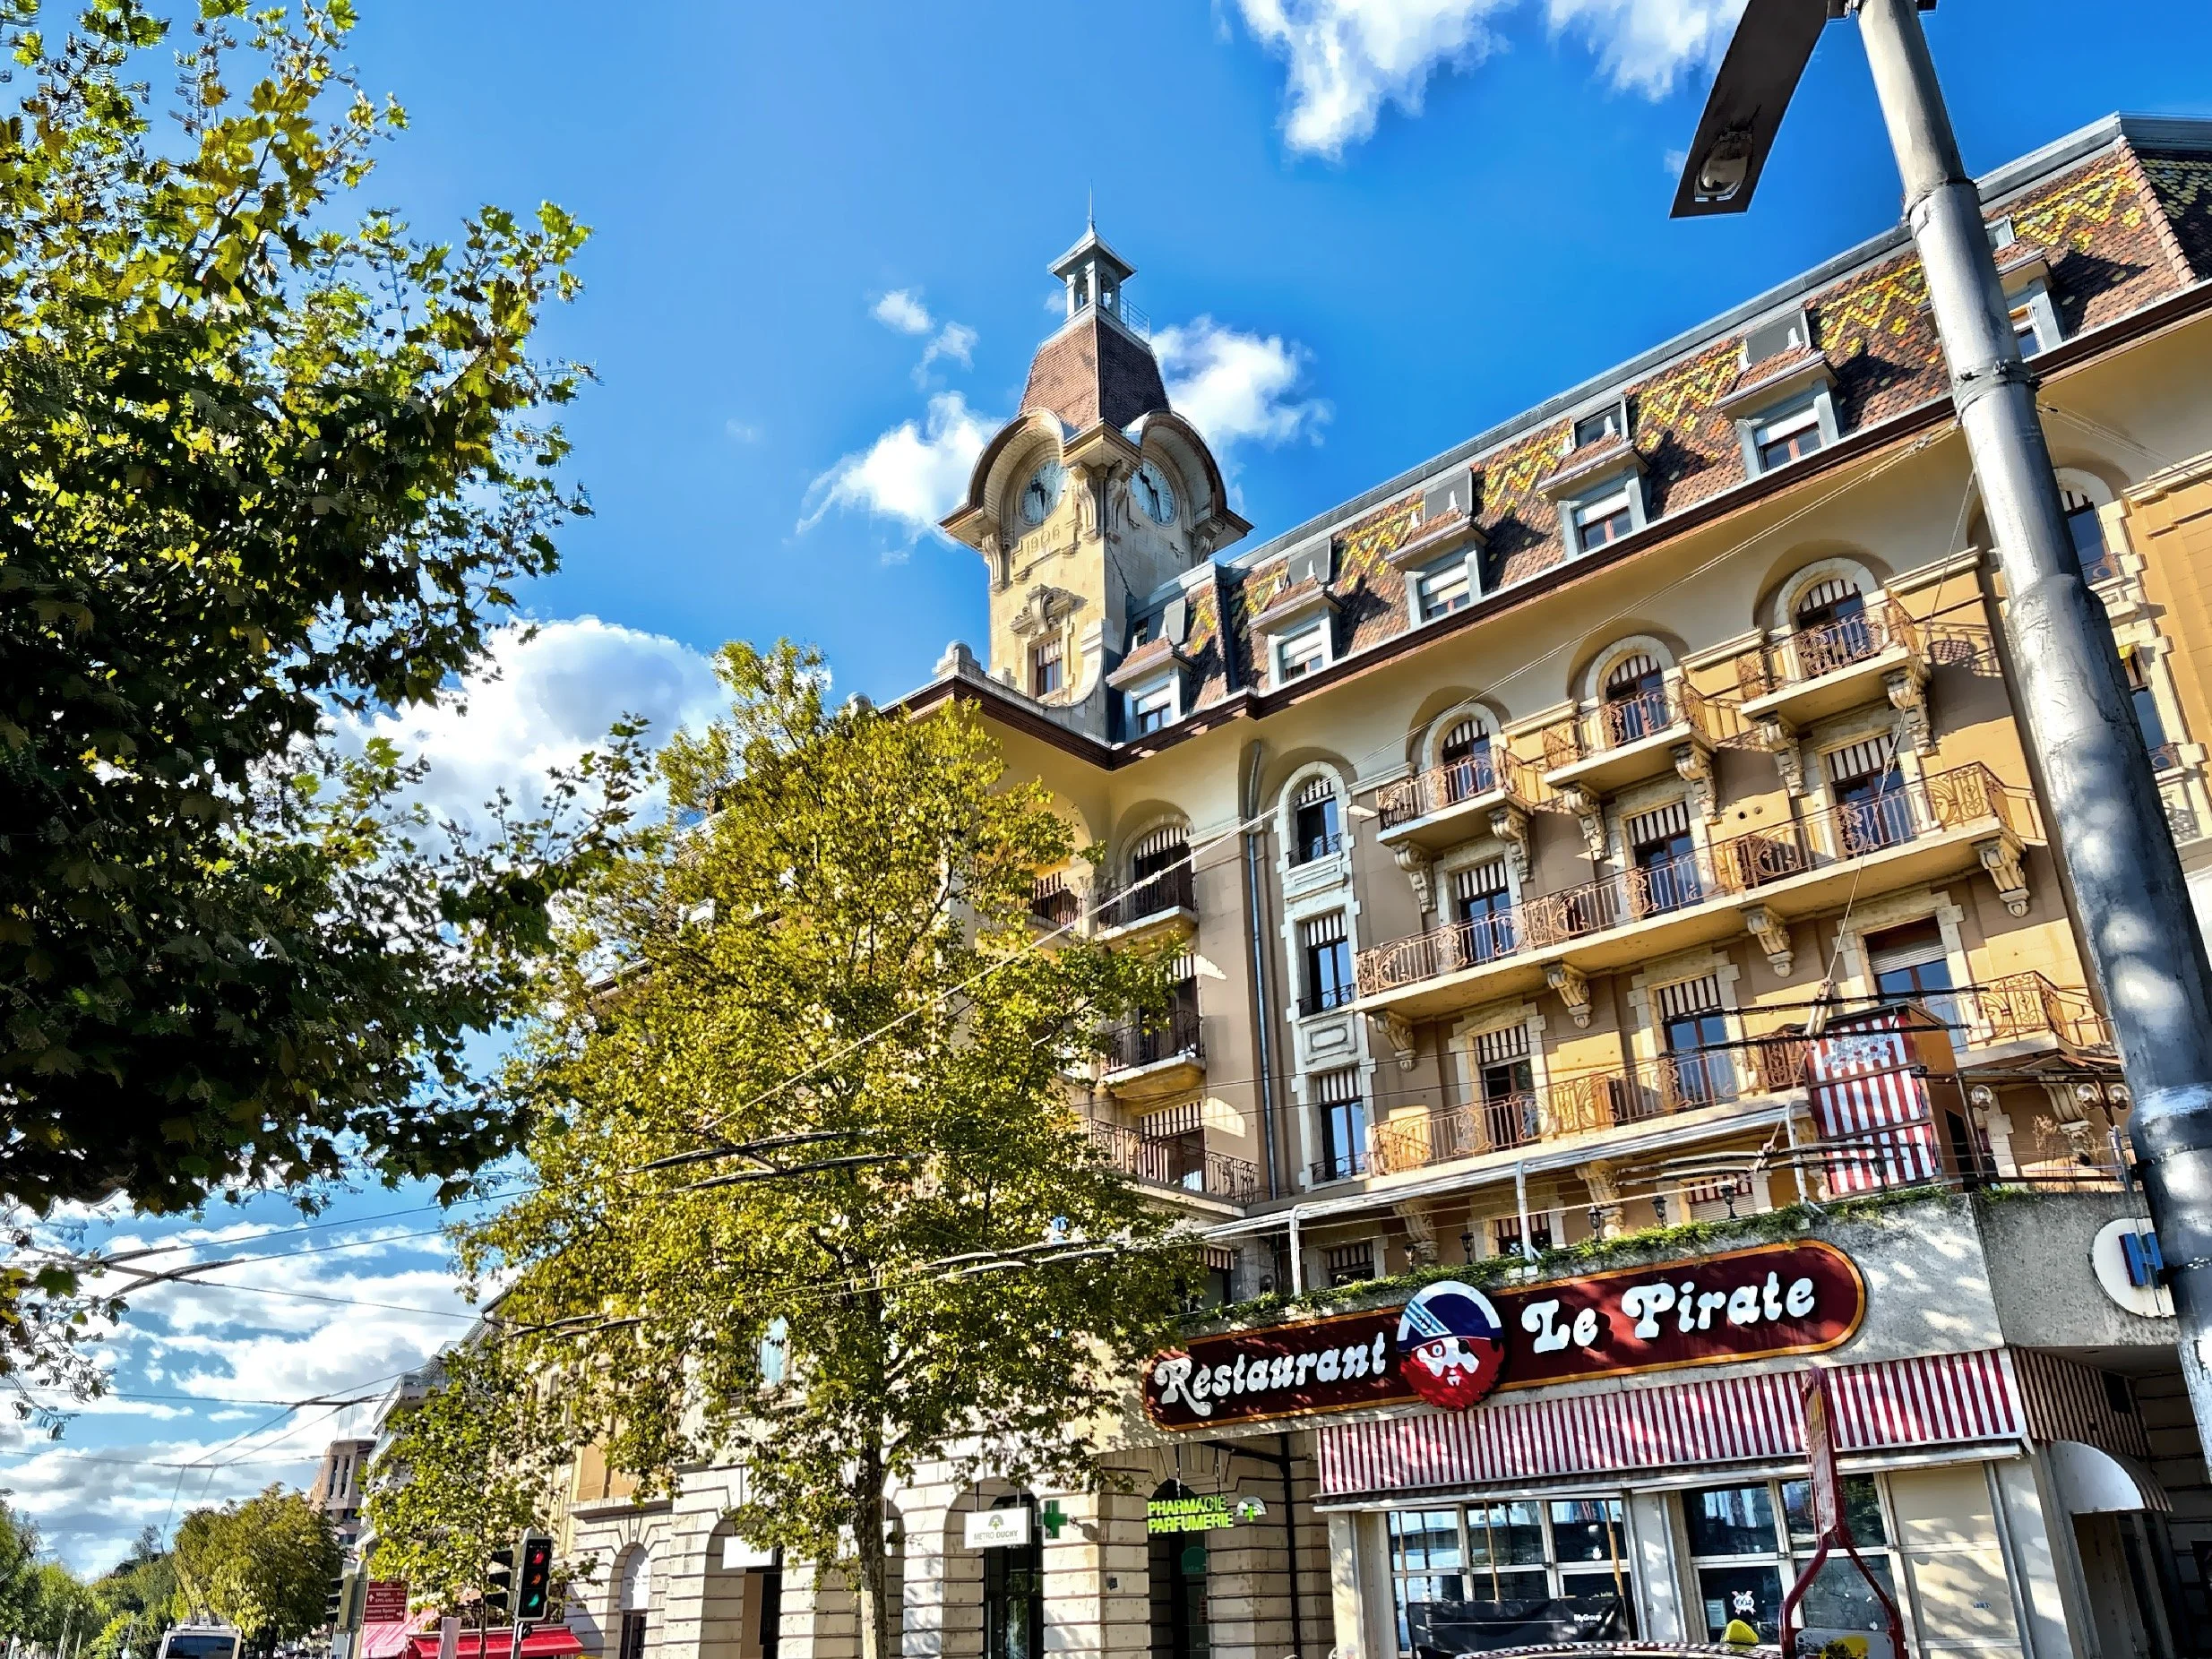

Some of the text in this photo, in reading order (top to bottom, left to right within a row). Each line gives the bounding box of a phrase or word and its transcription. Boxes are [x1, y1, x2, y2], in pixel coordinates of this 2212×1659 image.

[1154, 1271, 1815, 1416] Restaurant Le Pirate
[1147, 1494, 1227, 1517] PHARMACIE
[1147, 1512, 1235, 1534] PARFUMERIE
[974, 1532, 994, 1540] METRO
